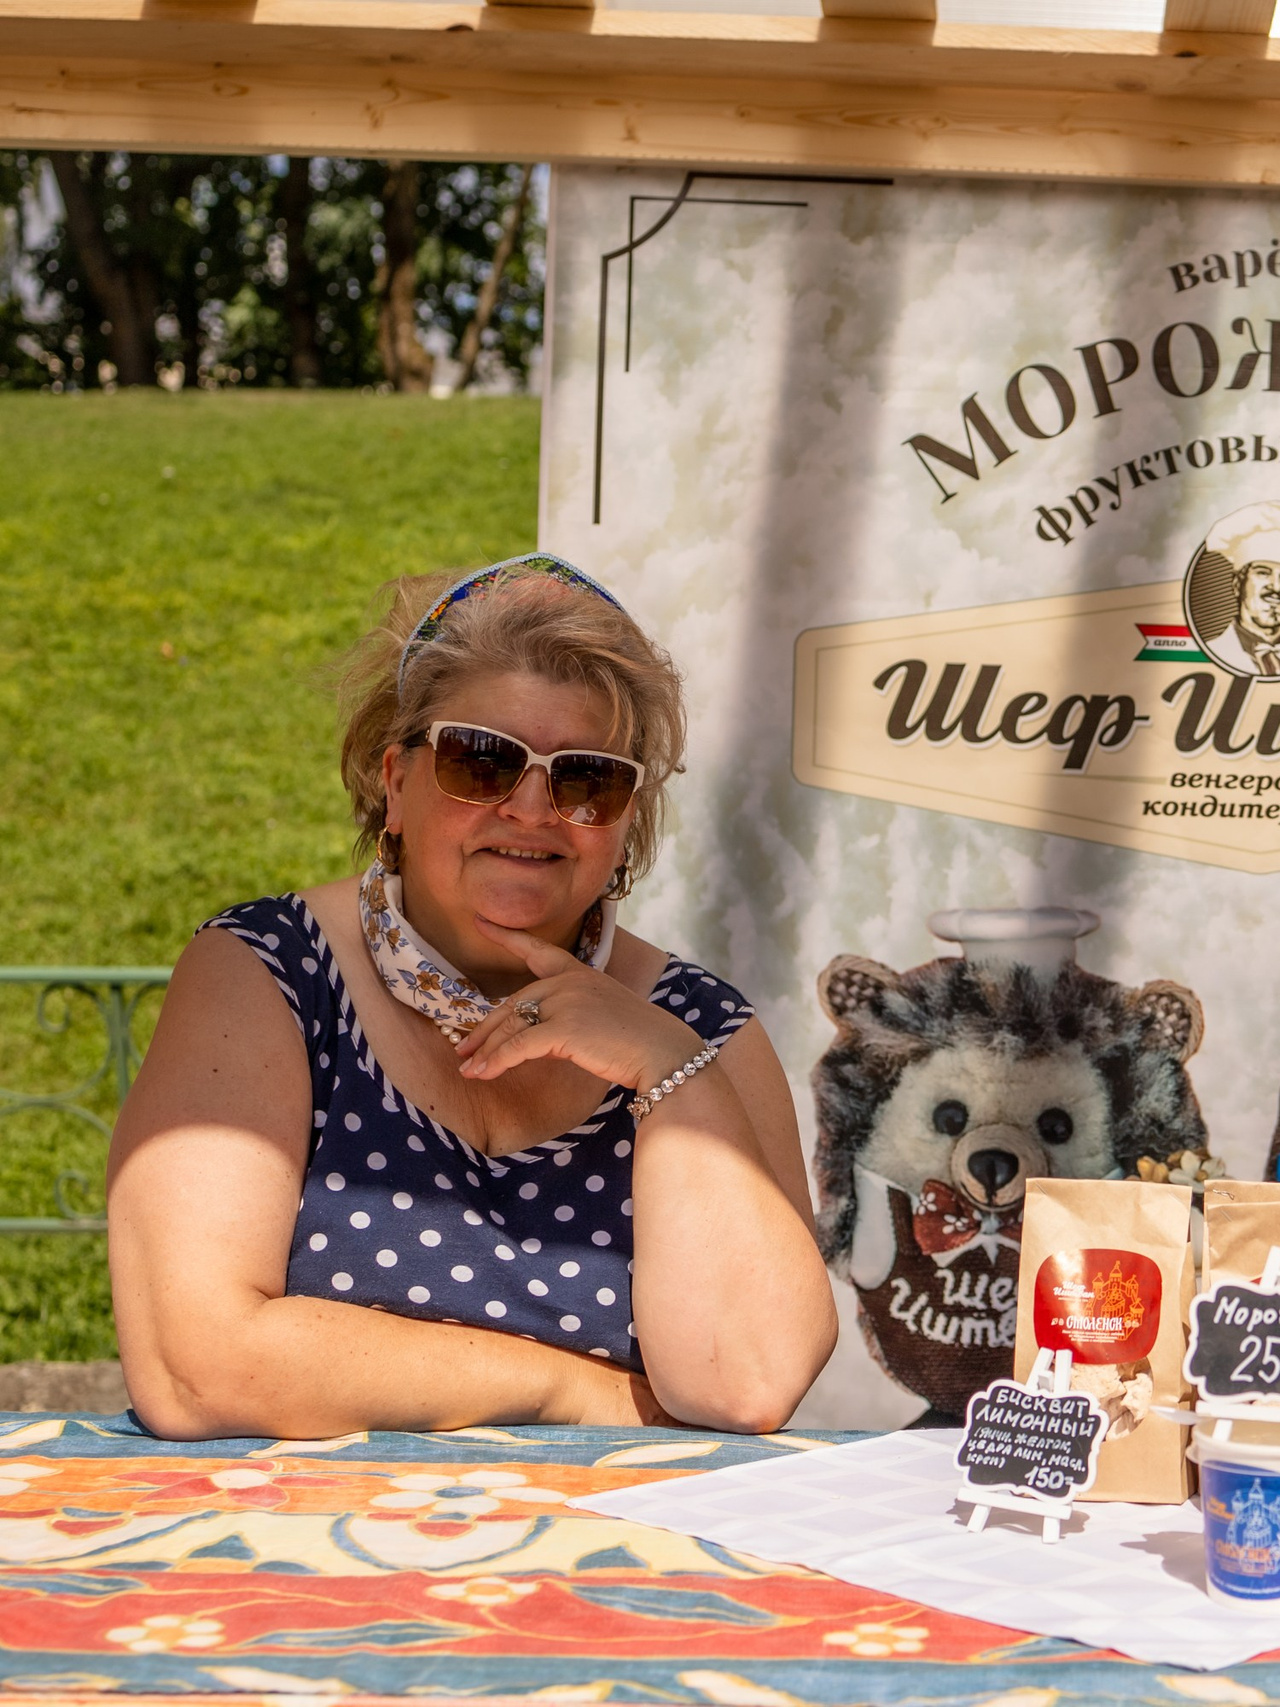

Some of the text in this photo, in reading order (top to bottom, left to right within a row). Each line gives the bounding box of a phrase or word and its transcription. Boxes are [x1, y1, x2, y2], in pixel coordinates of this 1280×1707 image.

[1153, 637, 1188, 649] anno
[1066, 1315, 1123, 1331] СМОЛЕНСК
[995, 1388, 1089, 1419] БИСКВИТ
[975, 1403, 1096, 1438] ЛИМОННЫЙ
